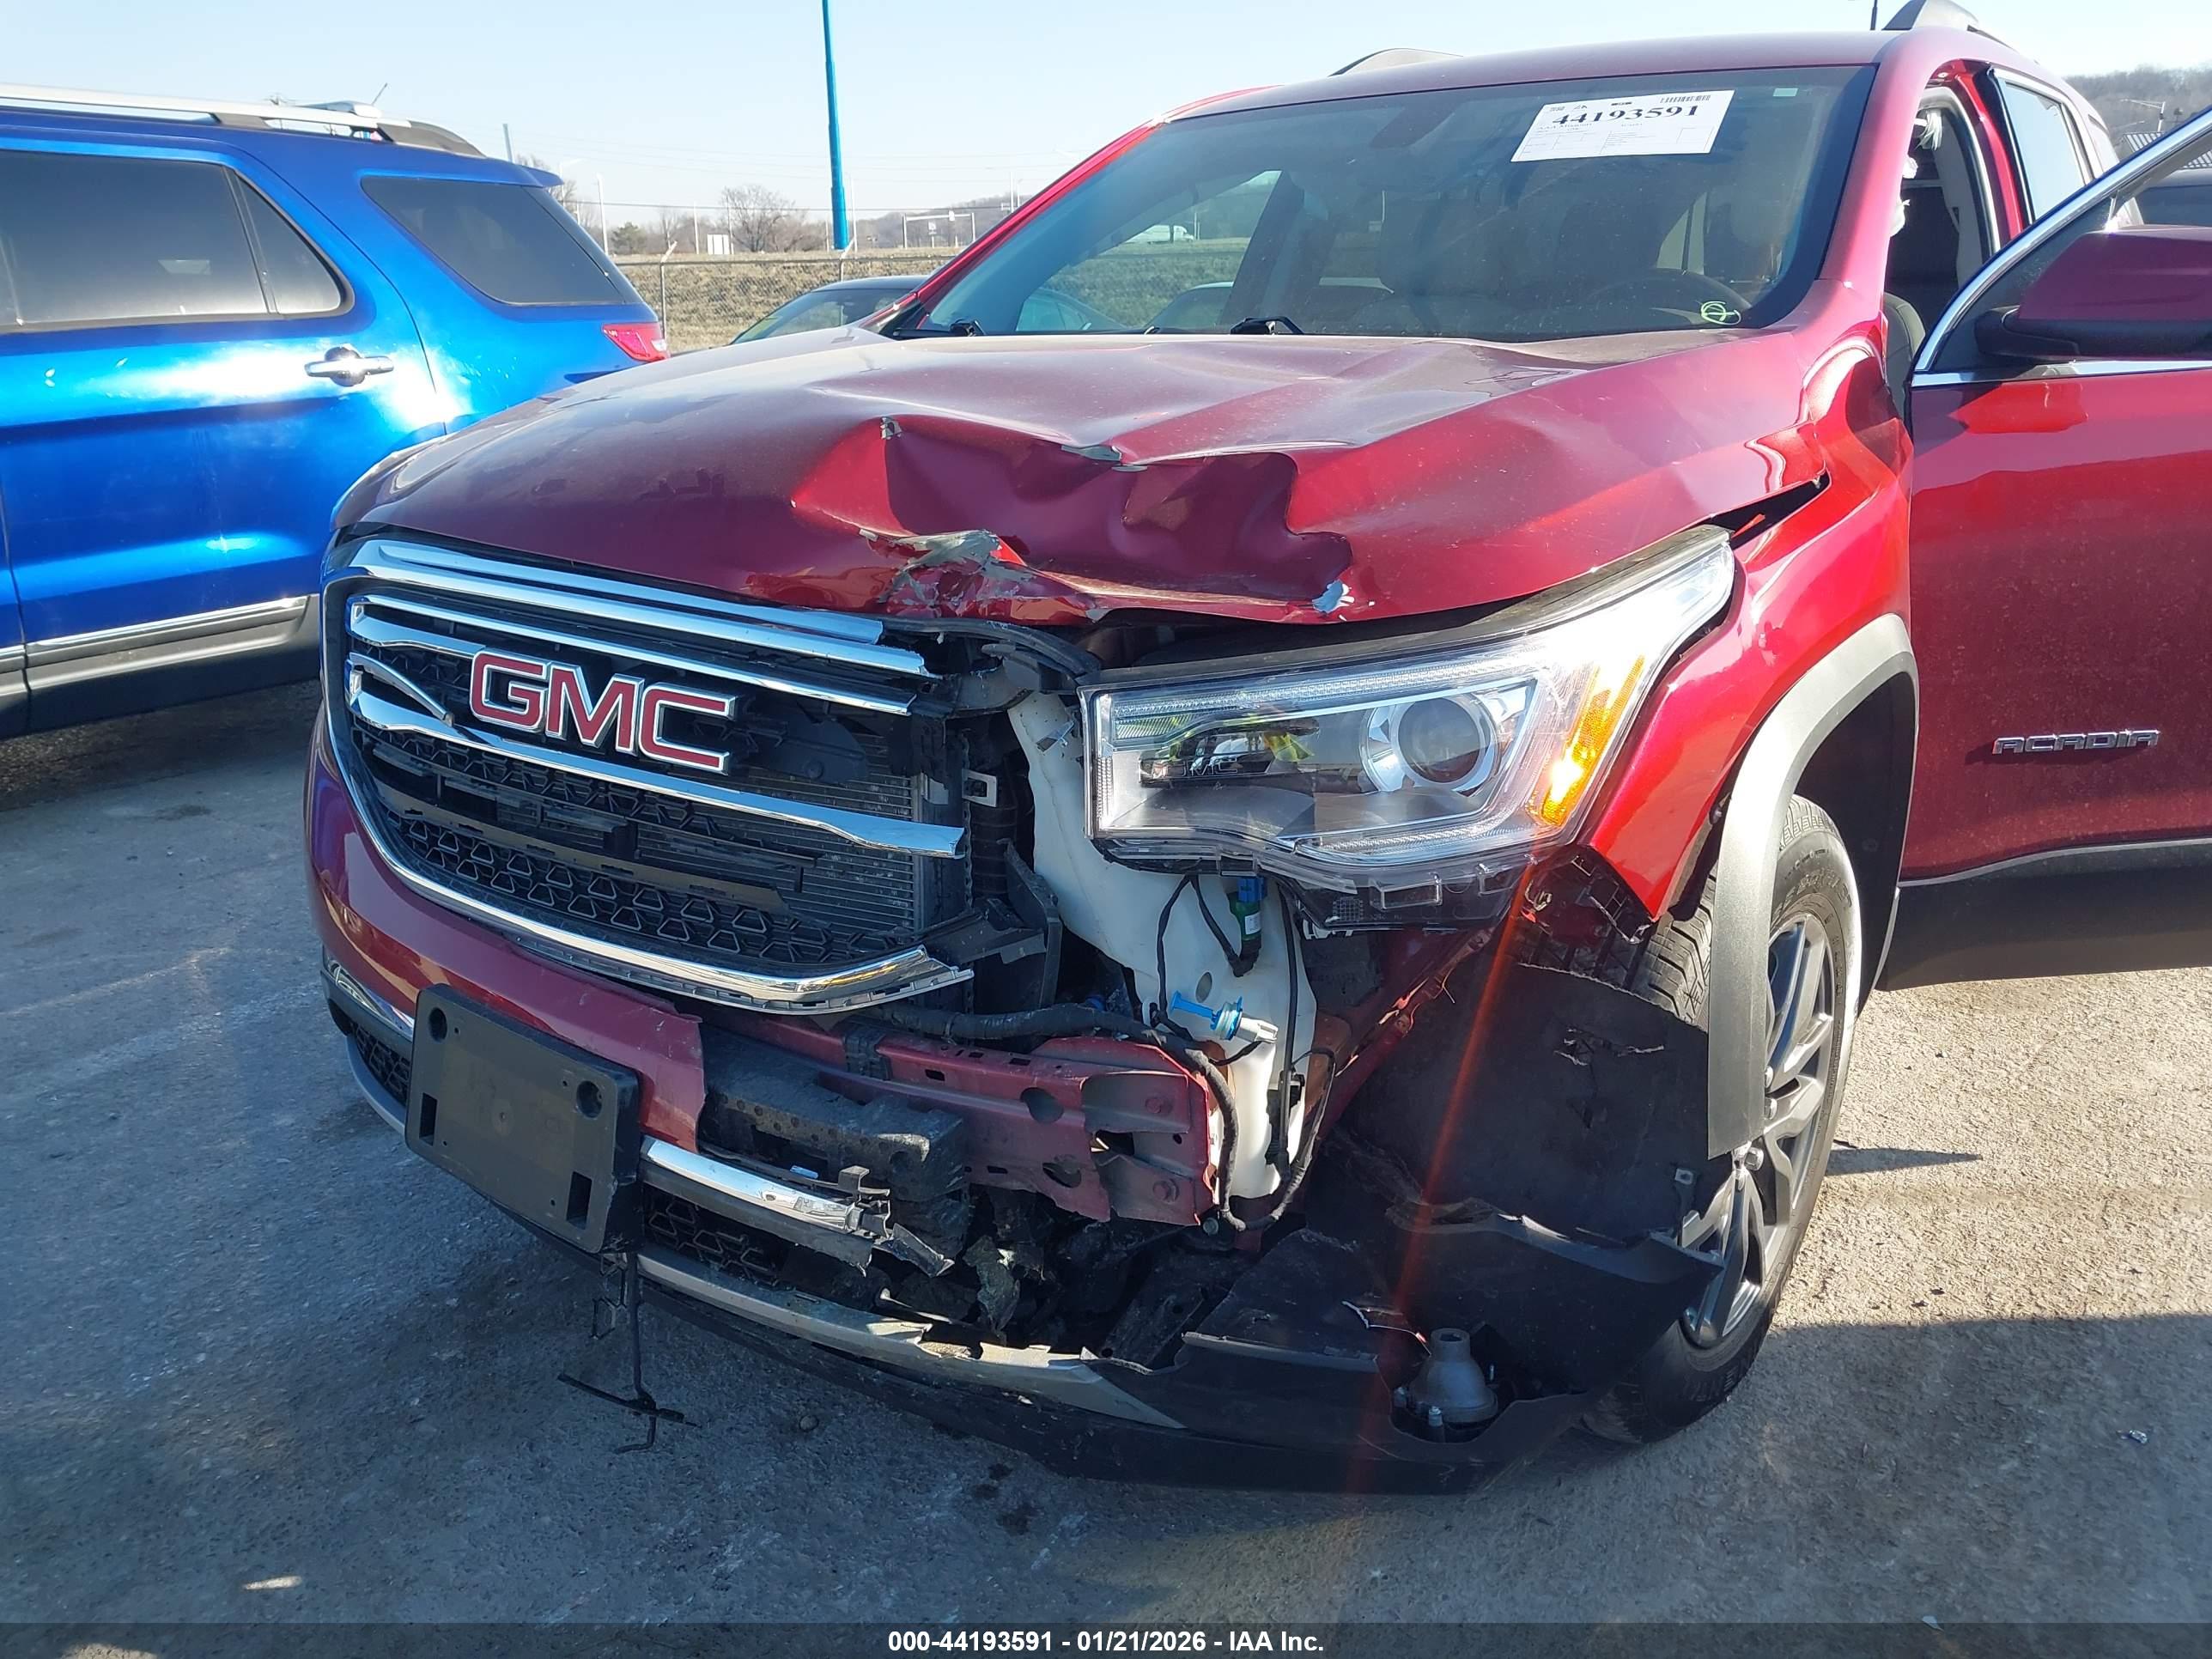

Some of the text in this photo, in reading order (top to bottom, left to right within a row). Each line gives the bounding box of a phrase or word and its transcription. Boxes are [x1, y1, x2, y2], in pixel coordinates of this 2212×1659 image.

[1552, 104, 1699, 125] 44193591
[469, 647, 738, 776] GMC
[1991, 728, 2160, 755] ACADIA
